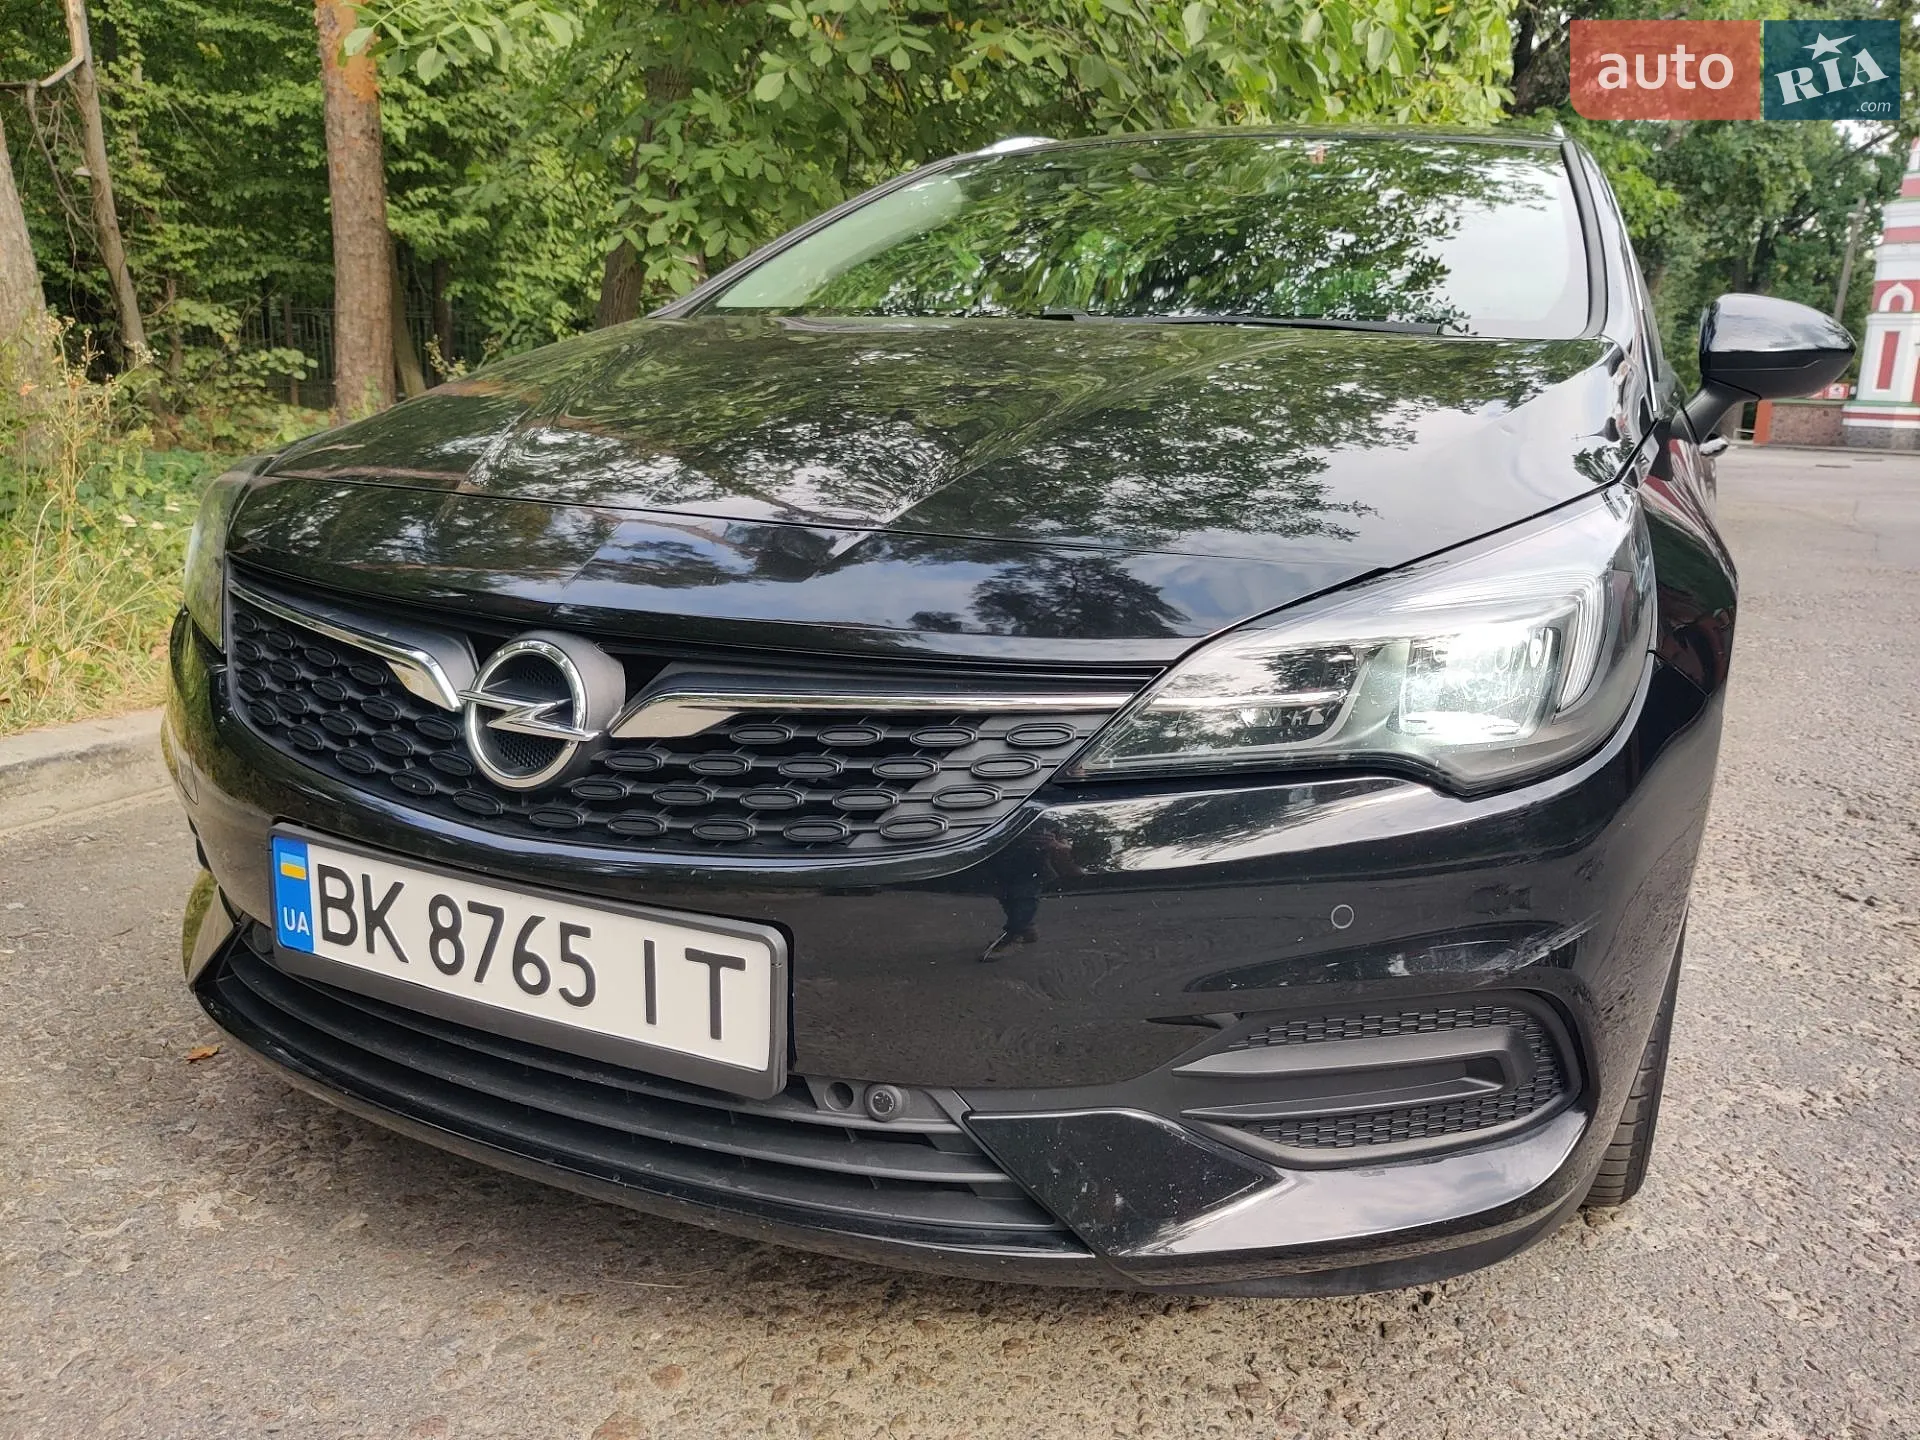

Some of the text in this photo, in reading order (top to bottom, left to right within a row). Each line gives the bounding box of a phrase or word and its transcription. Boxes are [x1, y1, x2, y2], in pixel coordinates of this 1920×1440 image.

[283, 905, 310, 937] UA
[317, 863, 409, 963] BK
[428, 893, 596, 1007] 8765
